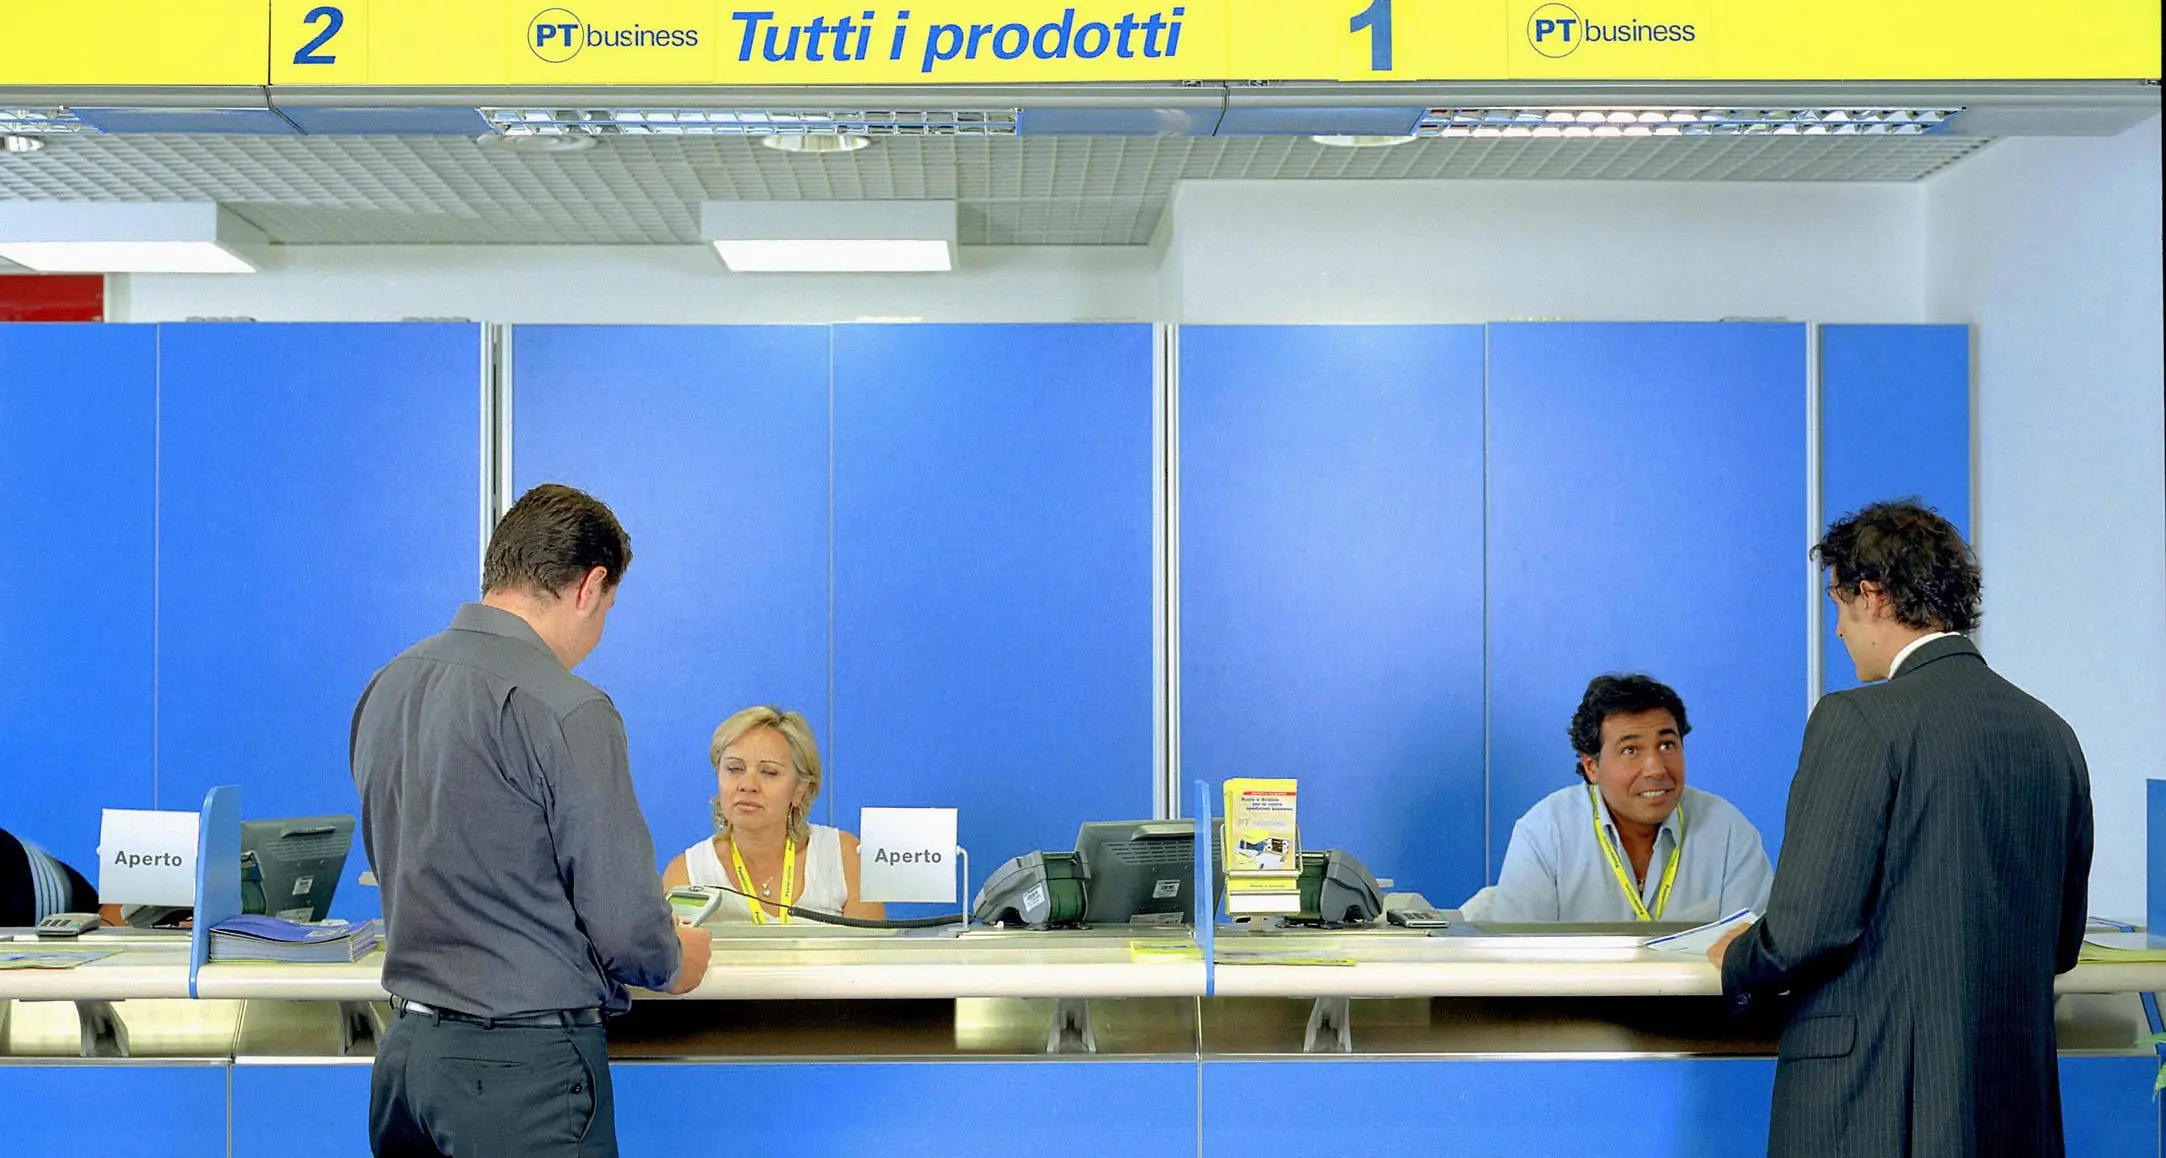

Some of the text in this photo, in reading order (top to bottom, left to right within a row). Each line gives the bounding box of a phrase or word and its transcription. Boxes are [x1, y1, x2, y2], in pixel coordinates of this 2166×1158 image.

[293, 7, 344, 64] 2
[535, 24, 698, 47] PT business
[732, 7, 1185, 73] Tutti i prodotti
[1349, 0, 1393, 71] 1
[1535, 19, 1696, 42] PT business
[114, 850, 183, 869] Aperto
[875, 848, 942, 866] Aperto
